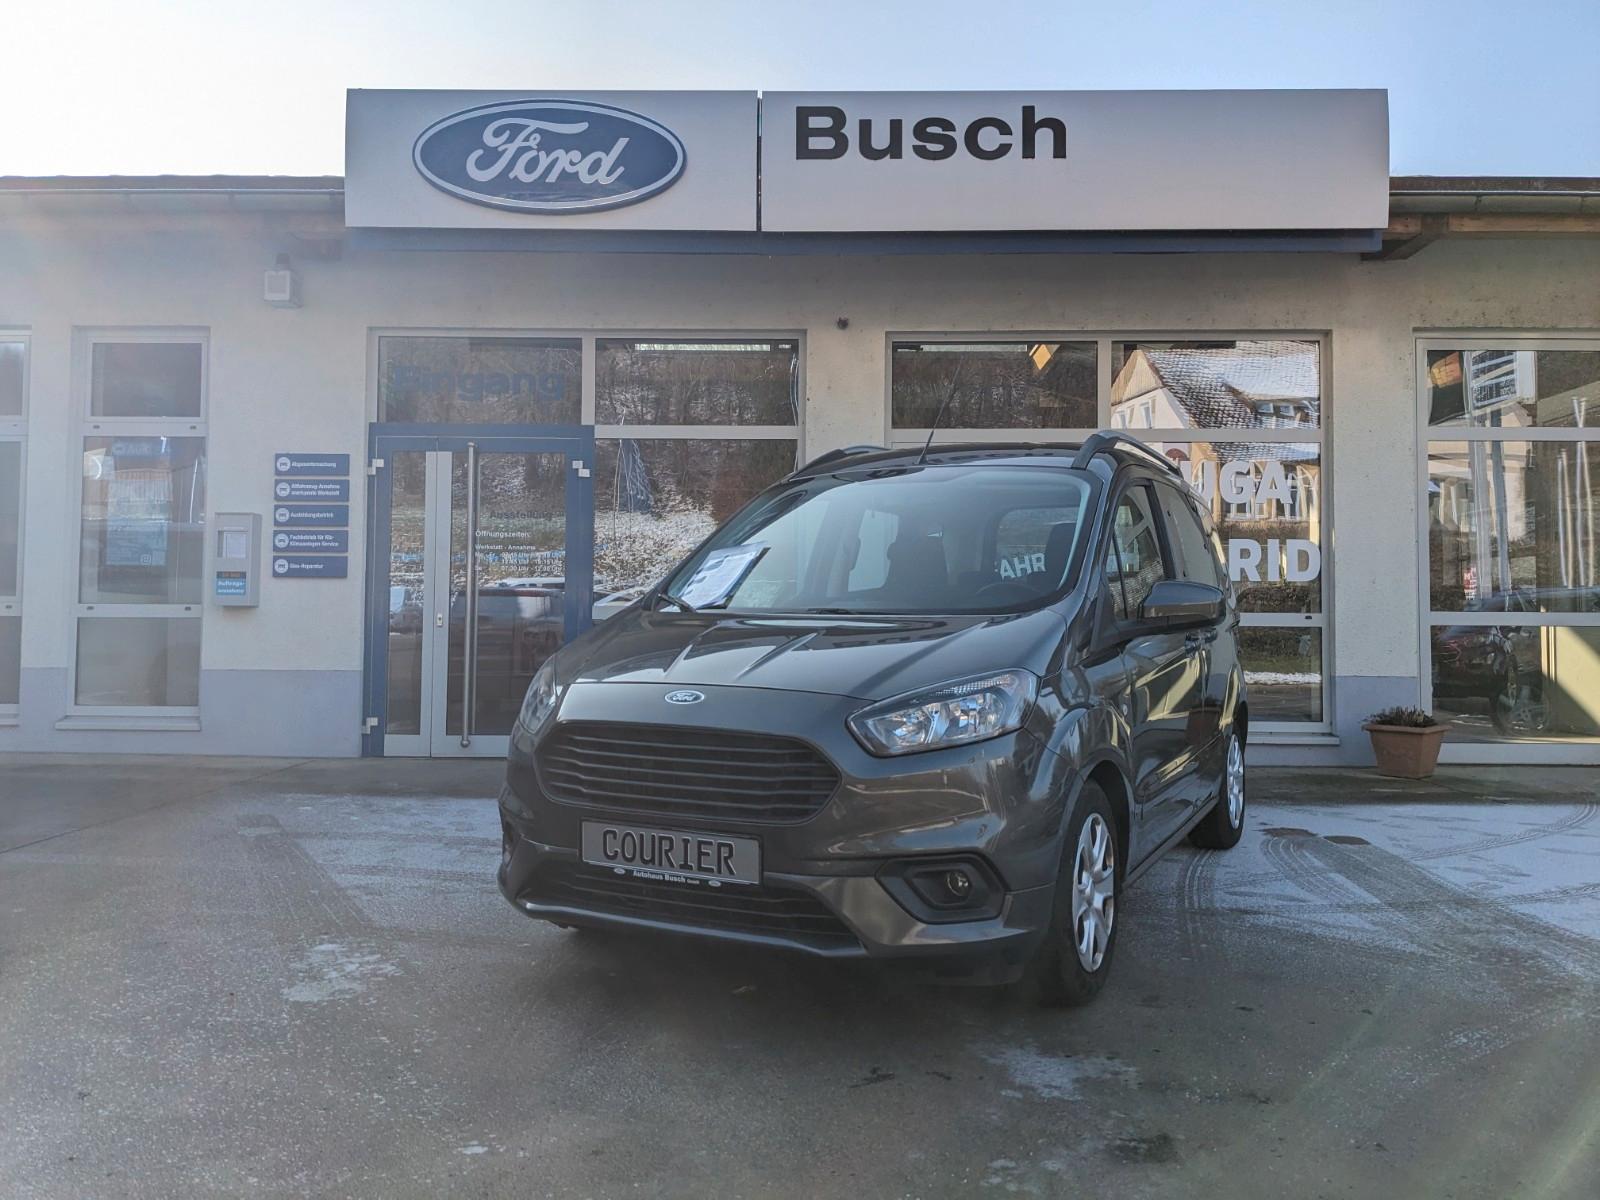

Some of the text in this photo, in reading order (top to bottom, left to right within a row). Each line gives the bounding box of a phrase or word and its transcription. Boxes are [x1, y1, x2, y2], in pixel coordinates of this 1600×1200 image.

[465, 117, 629, 185] Ford
[795, 105, 1067, 161] Busch
[392, 364, 566, 402] Eingang
[1179, 460, 1294, 505] UGA
[996, 552, 1047, 580] AHR
[1228, 538, 1321, 582] RID
[602, 828, 737, 876] COURIER
[632, 869, 664, 881] Autohaus
[664, 872, 687, 884] Busch
